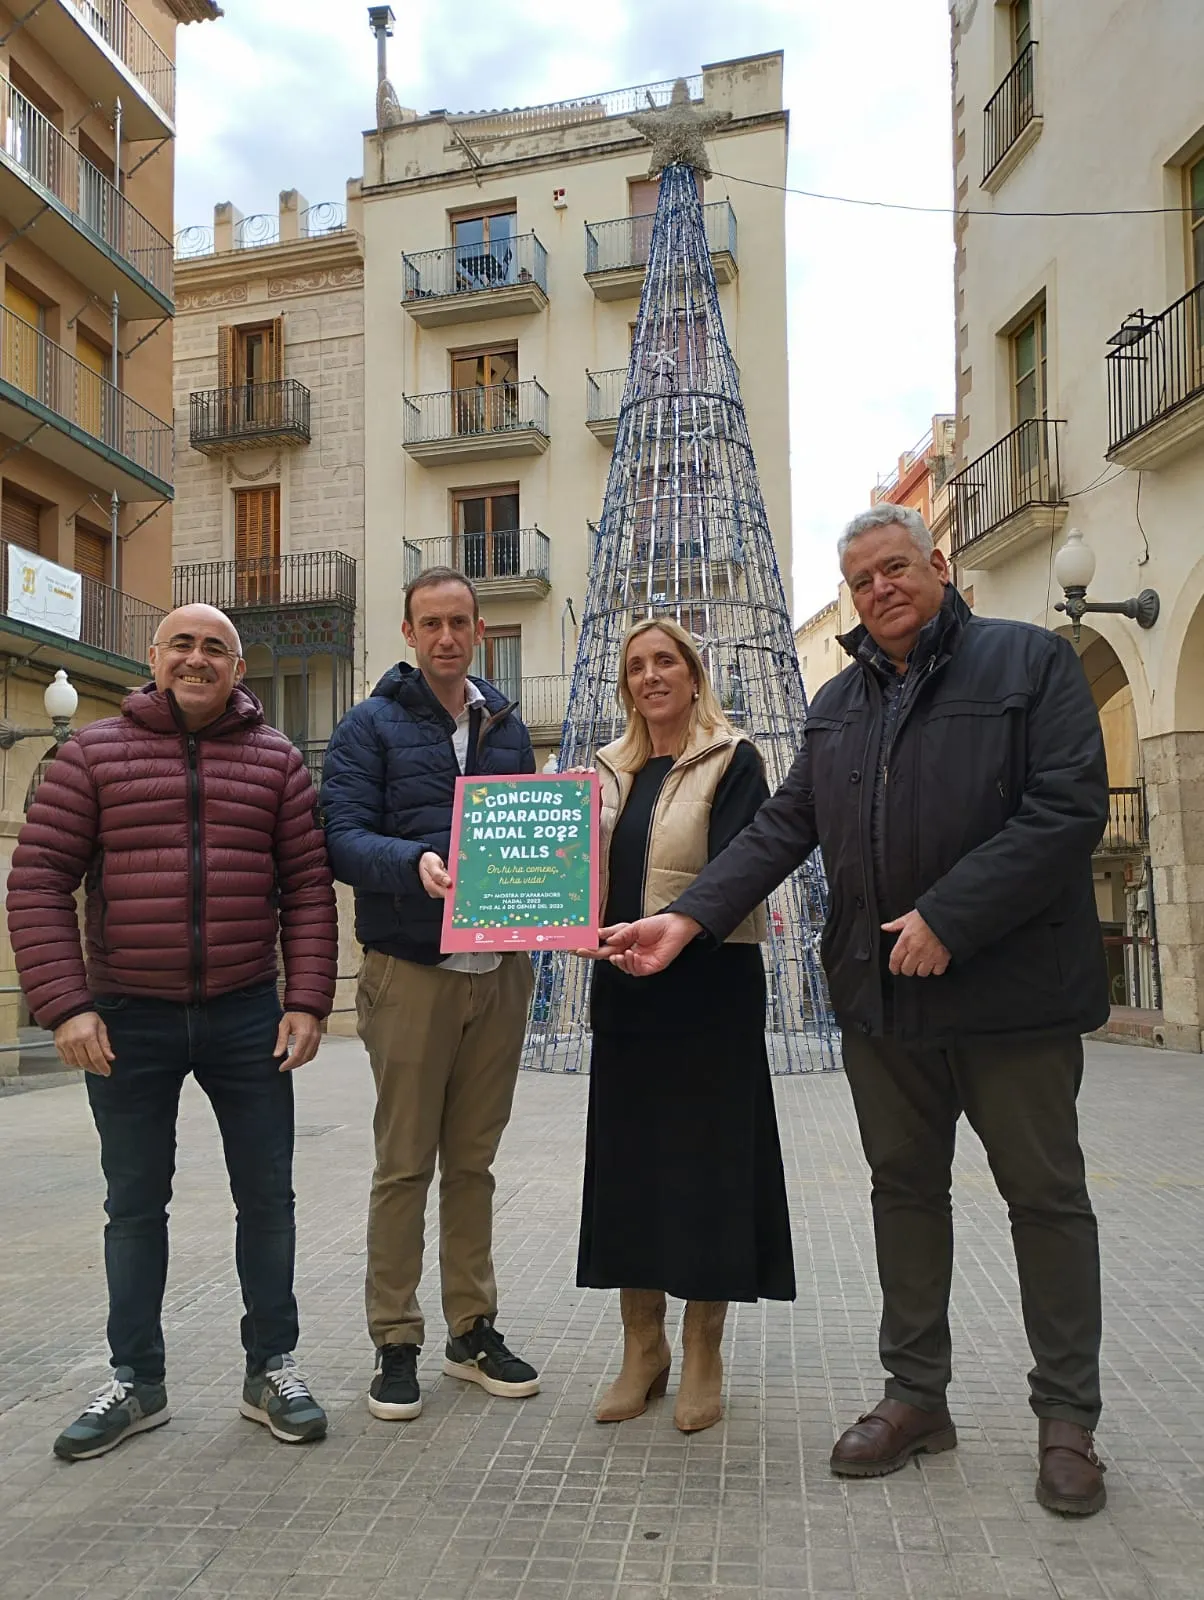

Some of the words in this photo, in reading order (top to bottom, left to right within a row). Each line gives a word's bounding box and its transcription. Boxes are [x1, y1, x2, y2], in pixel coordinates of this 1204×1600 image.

[485, 791, 563, 808] CONCURS
[471, 809, 582, 824] D'APARADORS
[473, 827, 526, 840] NADAL
[533, 825, 578, 839] 2022
[500, 845, 550, 859] VALLS
